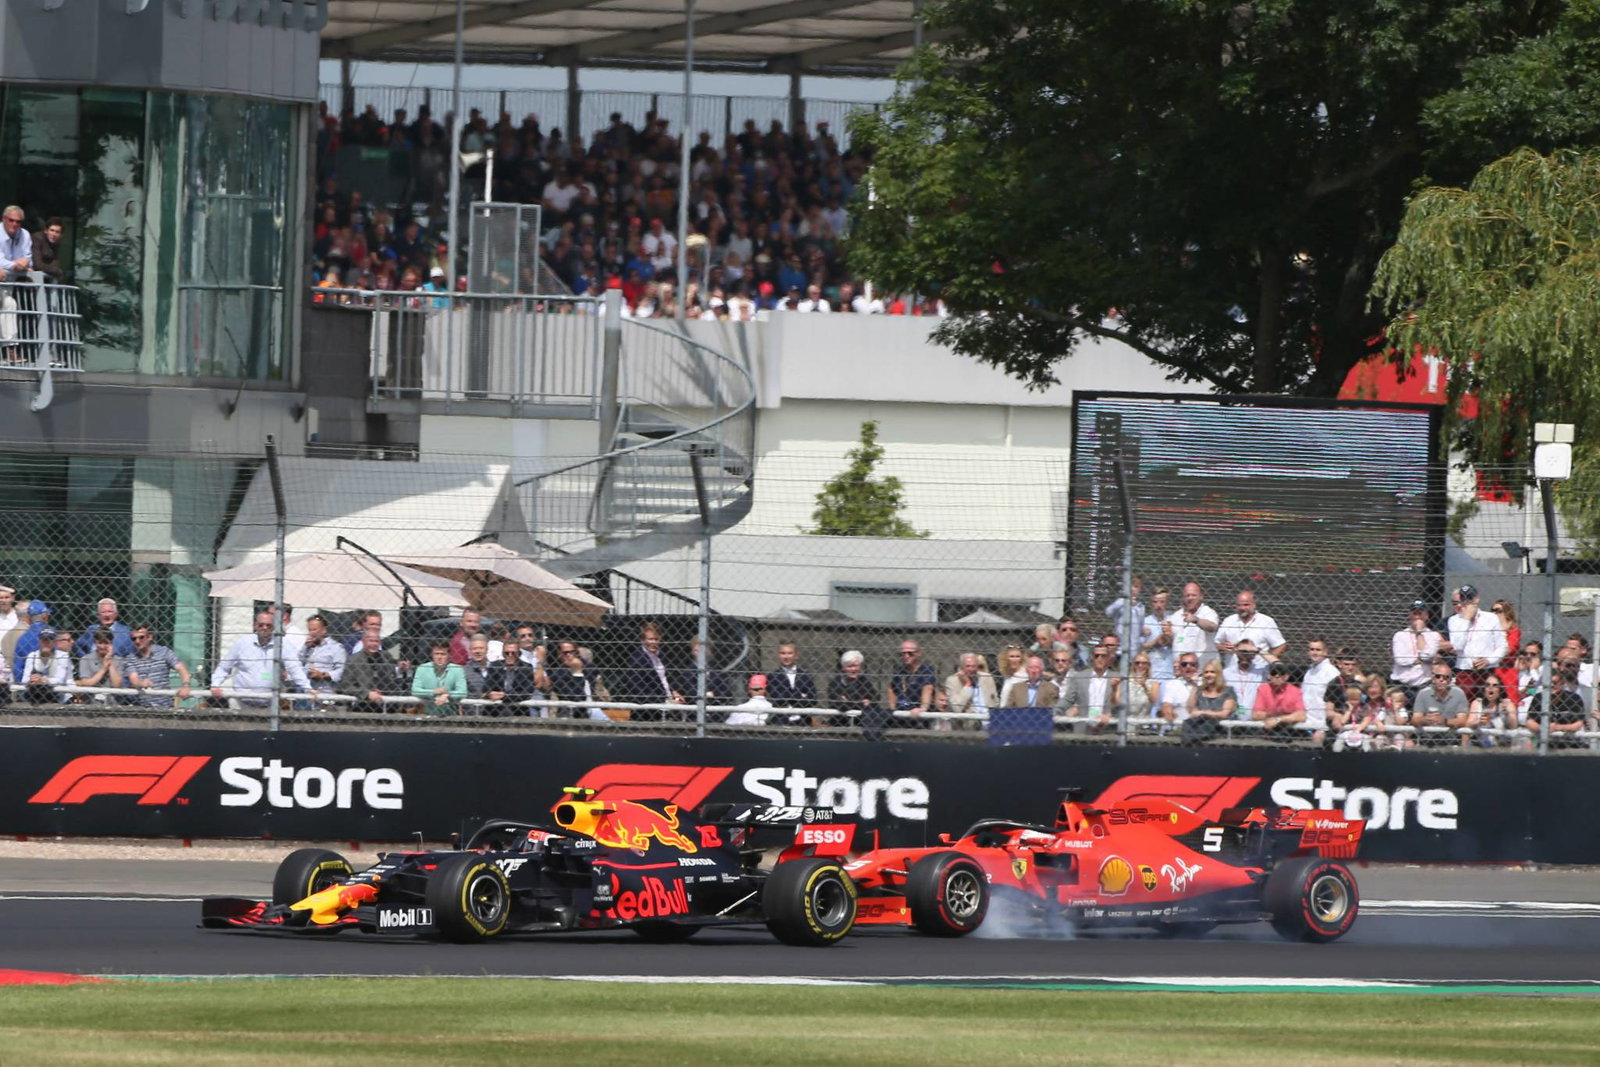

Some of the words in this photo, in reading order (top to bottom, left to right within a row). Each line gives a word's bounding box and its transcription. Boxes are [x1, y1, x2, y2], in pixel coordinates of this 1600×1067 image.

[219, 756, 403, 810] Store
[743, 766, 930, 821] Store
[1270, 776, 1459, 830] Store
[815, 809, 834, 821] AT&T
[1314, 820, 1349, 829] V-Power
[803, 829, 846, 844] ESSO
[1064, 840, 1094, 848] HUBLOT
[1202, 827, 1225, 852] 5
[677, 857, 717, 867] HONDA
[379, 908, 415, 928] Mobil
